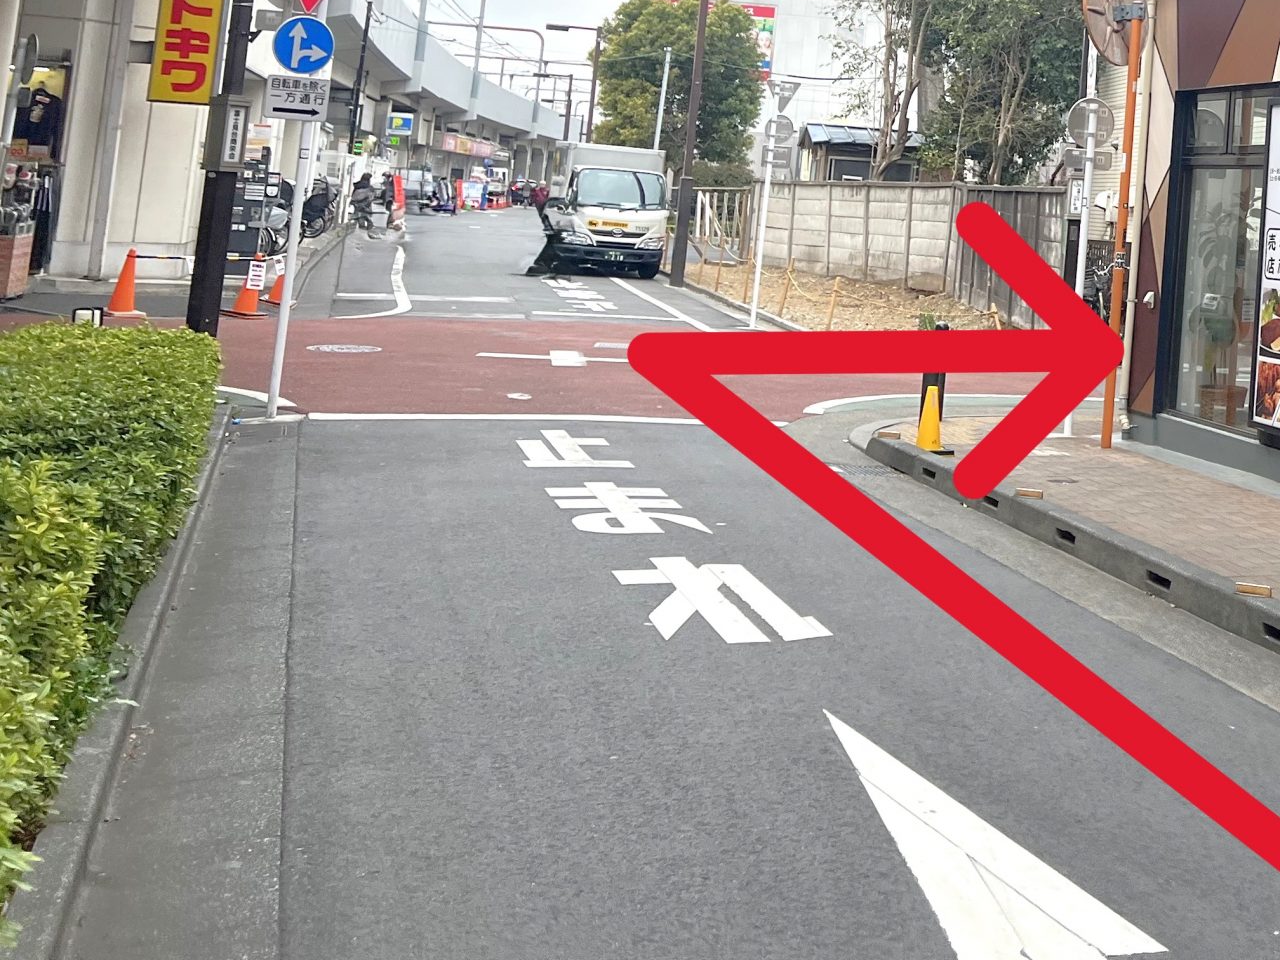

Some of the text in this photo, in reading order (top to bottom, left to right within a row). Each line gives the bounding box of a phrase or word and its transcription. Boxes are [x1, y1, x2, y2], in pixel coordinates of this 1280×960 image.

[271, 77, 327, 93] 自転車を除く
[270, 92, 326, 106] 一方通行
[515, 429, 834, 644] 止まれ
